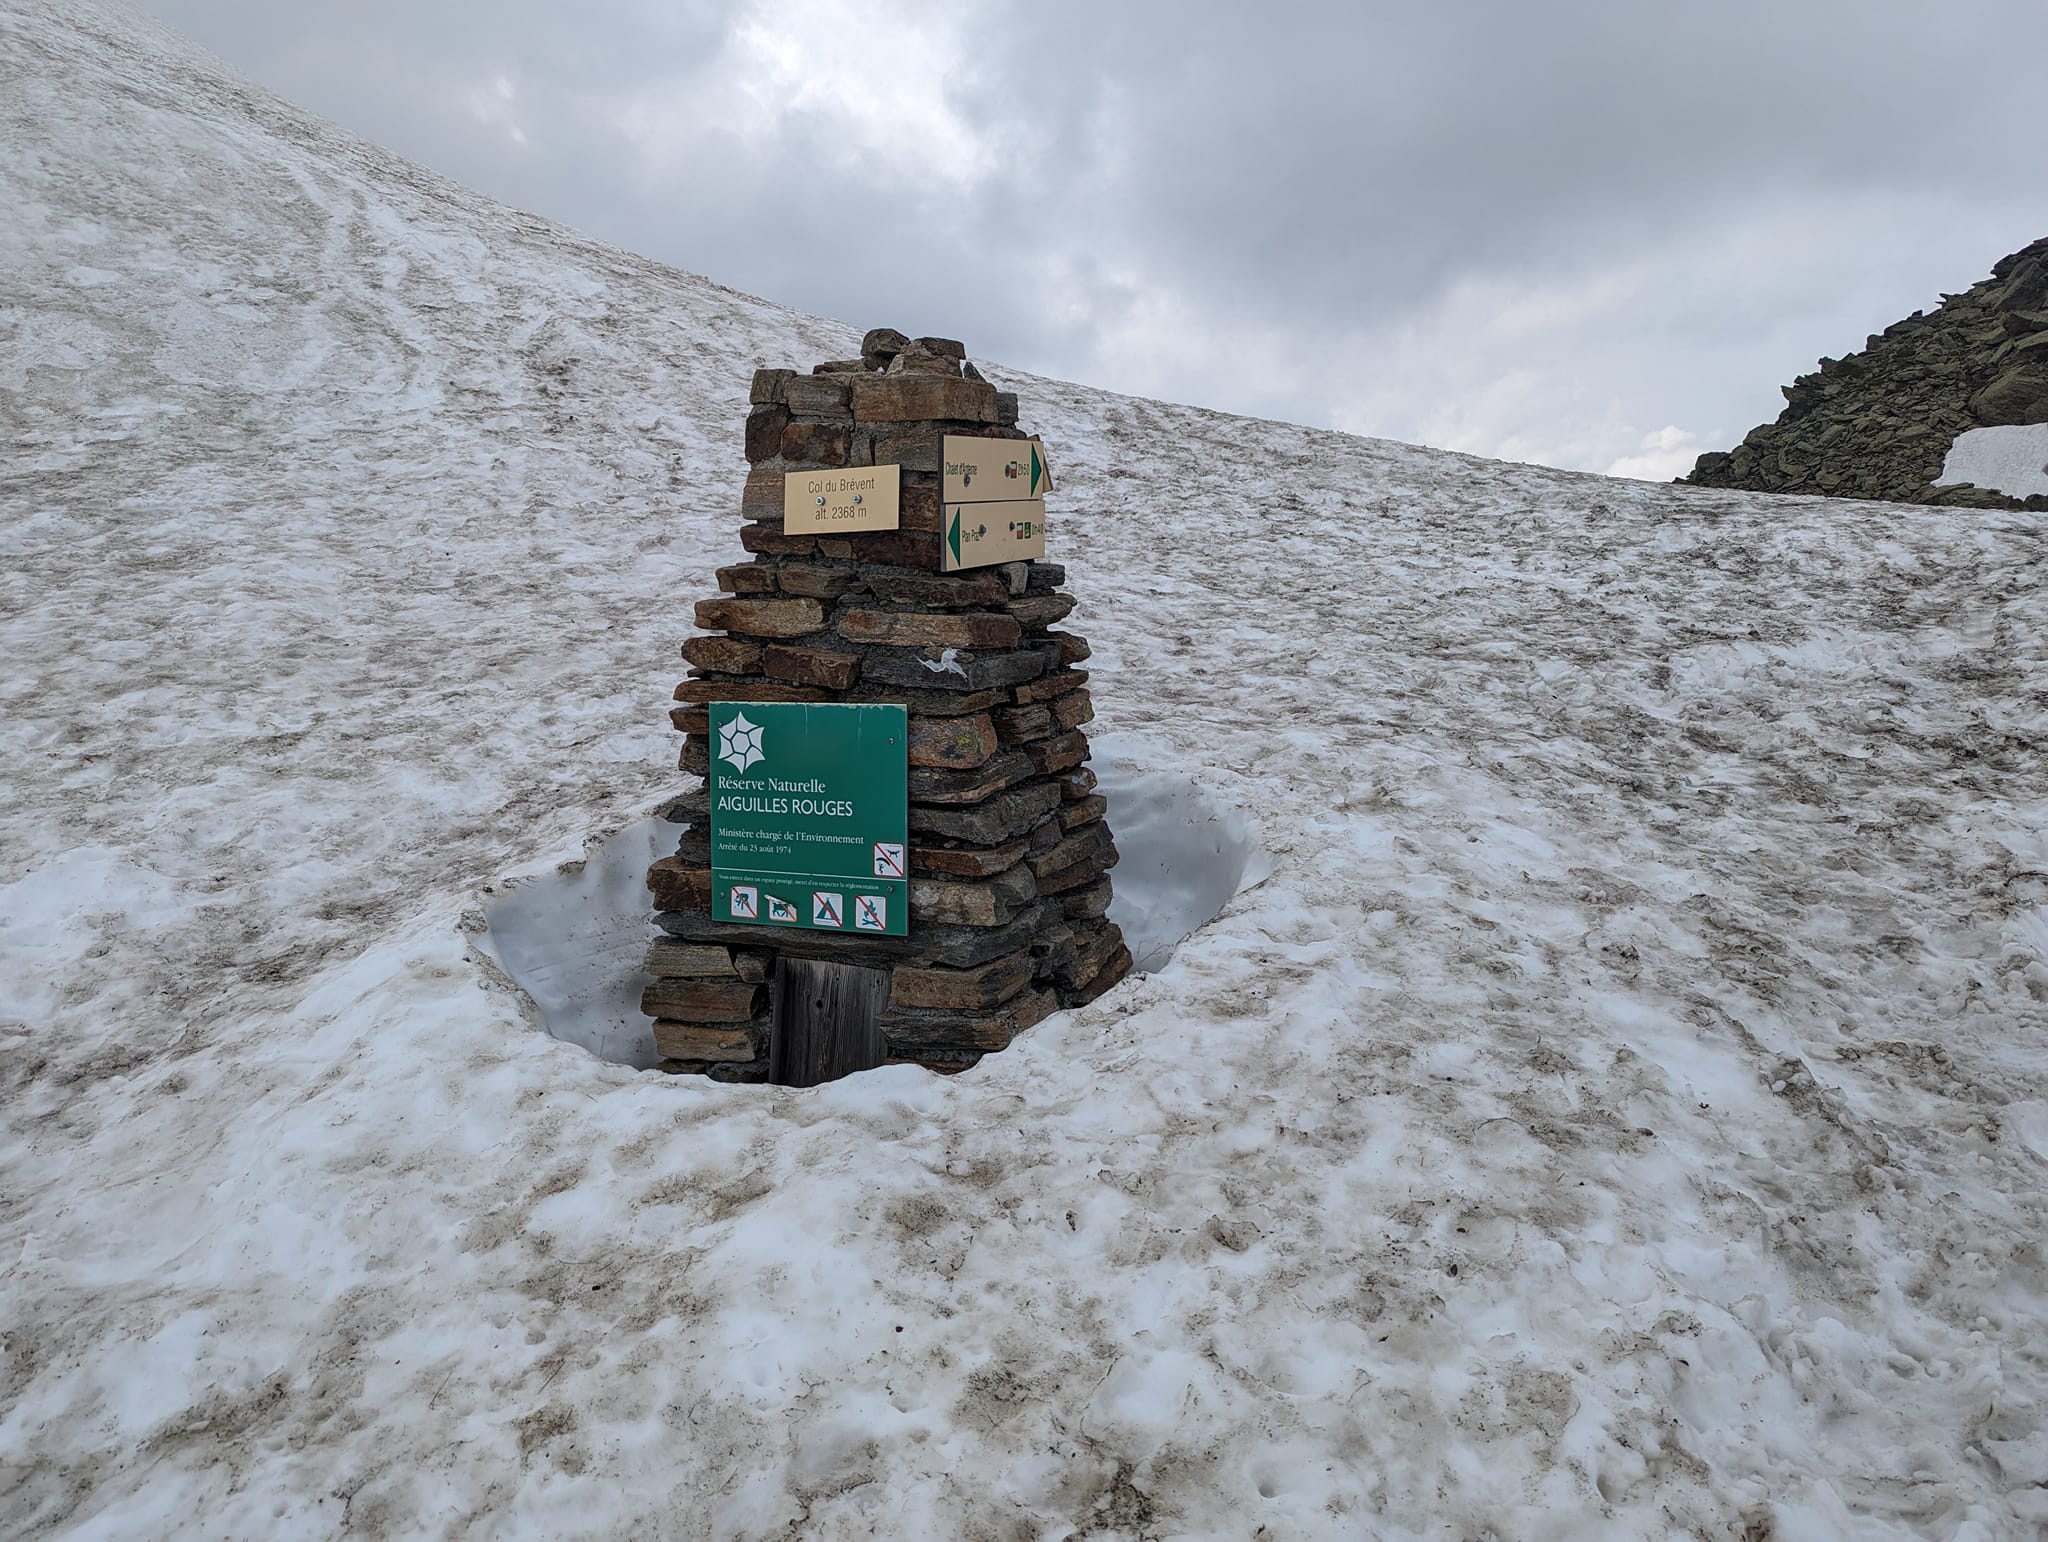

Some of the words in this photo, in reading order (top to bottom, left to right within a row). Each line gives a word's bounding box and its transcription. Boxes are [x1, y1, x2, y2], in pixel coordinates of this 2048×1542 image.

[808, 480, 823, 493] Col
[825, 480, 837, 492] du
[840, 477, 875, 491] Brévent
[815, 507, 829, 520] alt.
[832, 506, 855, 519] 2368
[858, 507, 867, 518] m
[718, 775, 765, 791] Réserve
[768, 777, 826, 793] Naturelle
[717, 796, 788, 814] AIGUILLES
[792, 799, 853, 816] ROUGES
[718, 827, 754, 838] Ministère
[755, 829, 782, 841] chargé
[783, 831, 794, 840] de
[796, 831, 864, 844] l'Environnement
[718, 842, 738, 851] Arrêté
[739, 843, 748, 851] du
[759, 844, 774, 853] août
